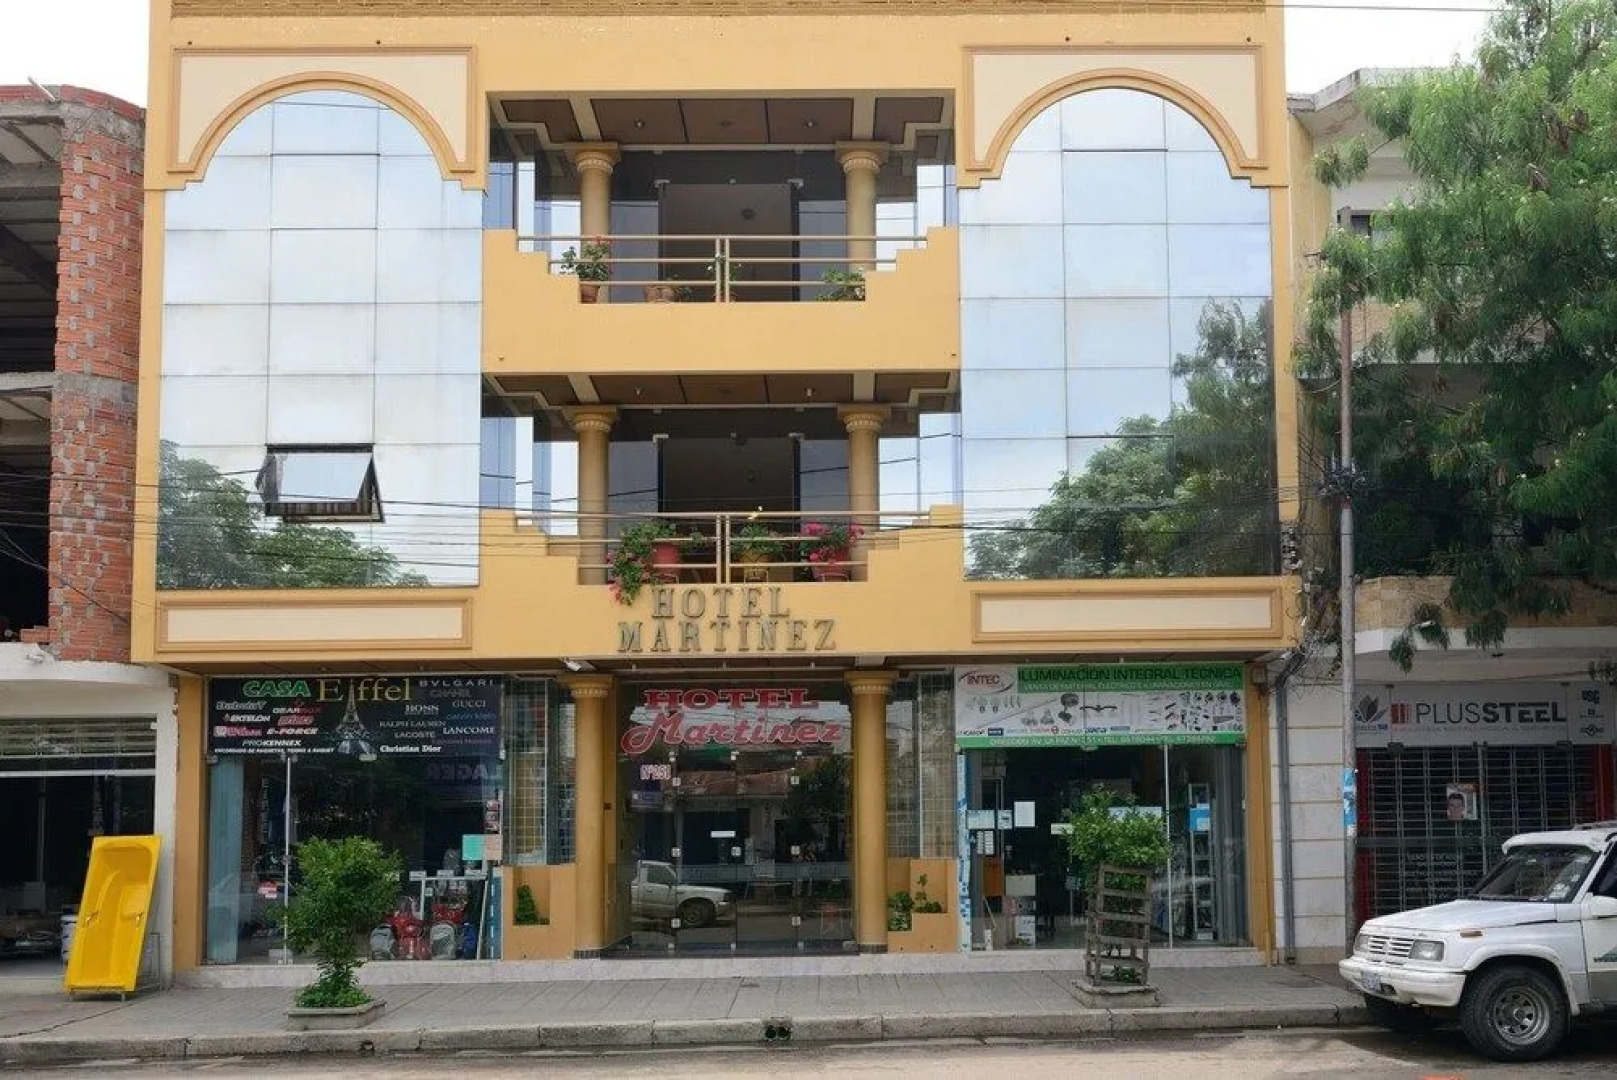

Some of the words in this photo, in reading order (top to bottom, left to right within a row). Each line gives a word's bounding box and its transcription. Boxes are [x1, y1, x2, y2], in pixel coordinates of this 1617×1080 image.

[651, 586, 790, 618] HOTEL
[617, 618, 837, 652] MARTINEZ
[242, 680, 312, 698] CASA
[316, 677, 412, 702] Eiffel
[419, 679, 494, 687] BVLGARI
[967, 674, 1000, 685] INTEC
[453, 700, 487, 708] GUCCI
[643, 689, 819, 711] HOTEL
[620, 710, 843, 755] Martinez
[380, 744, 420, 753] Christian
[422, 744, 442, 753] Dior
